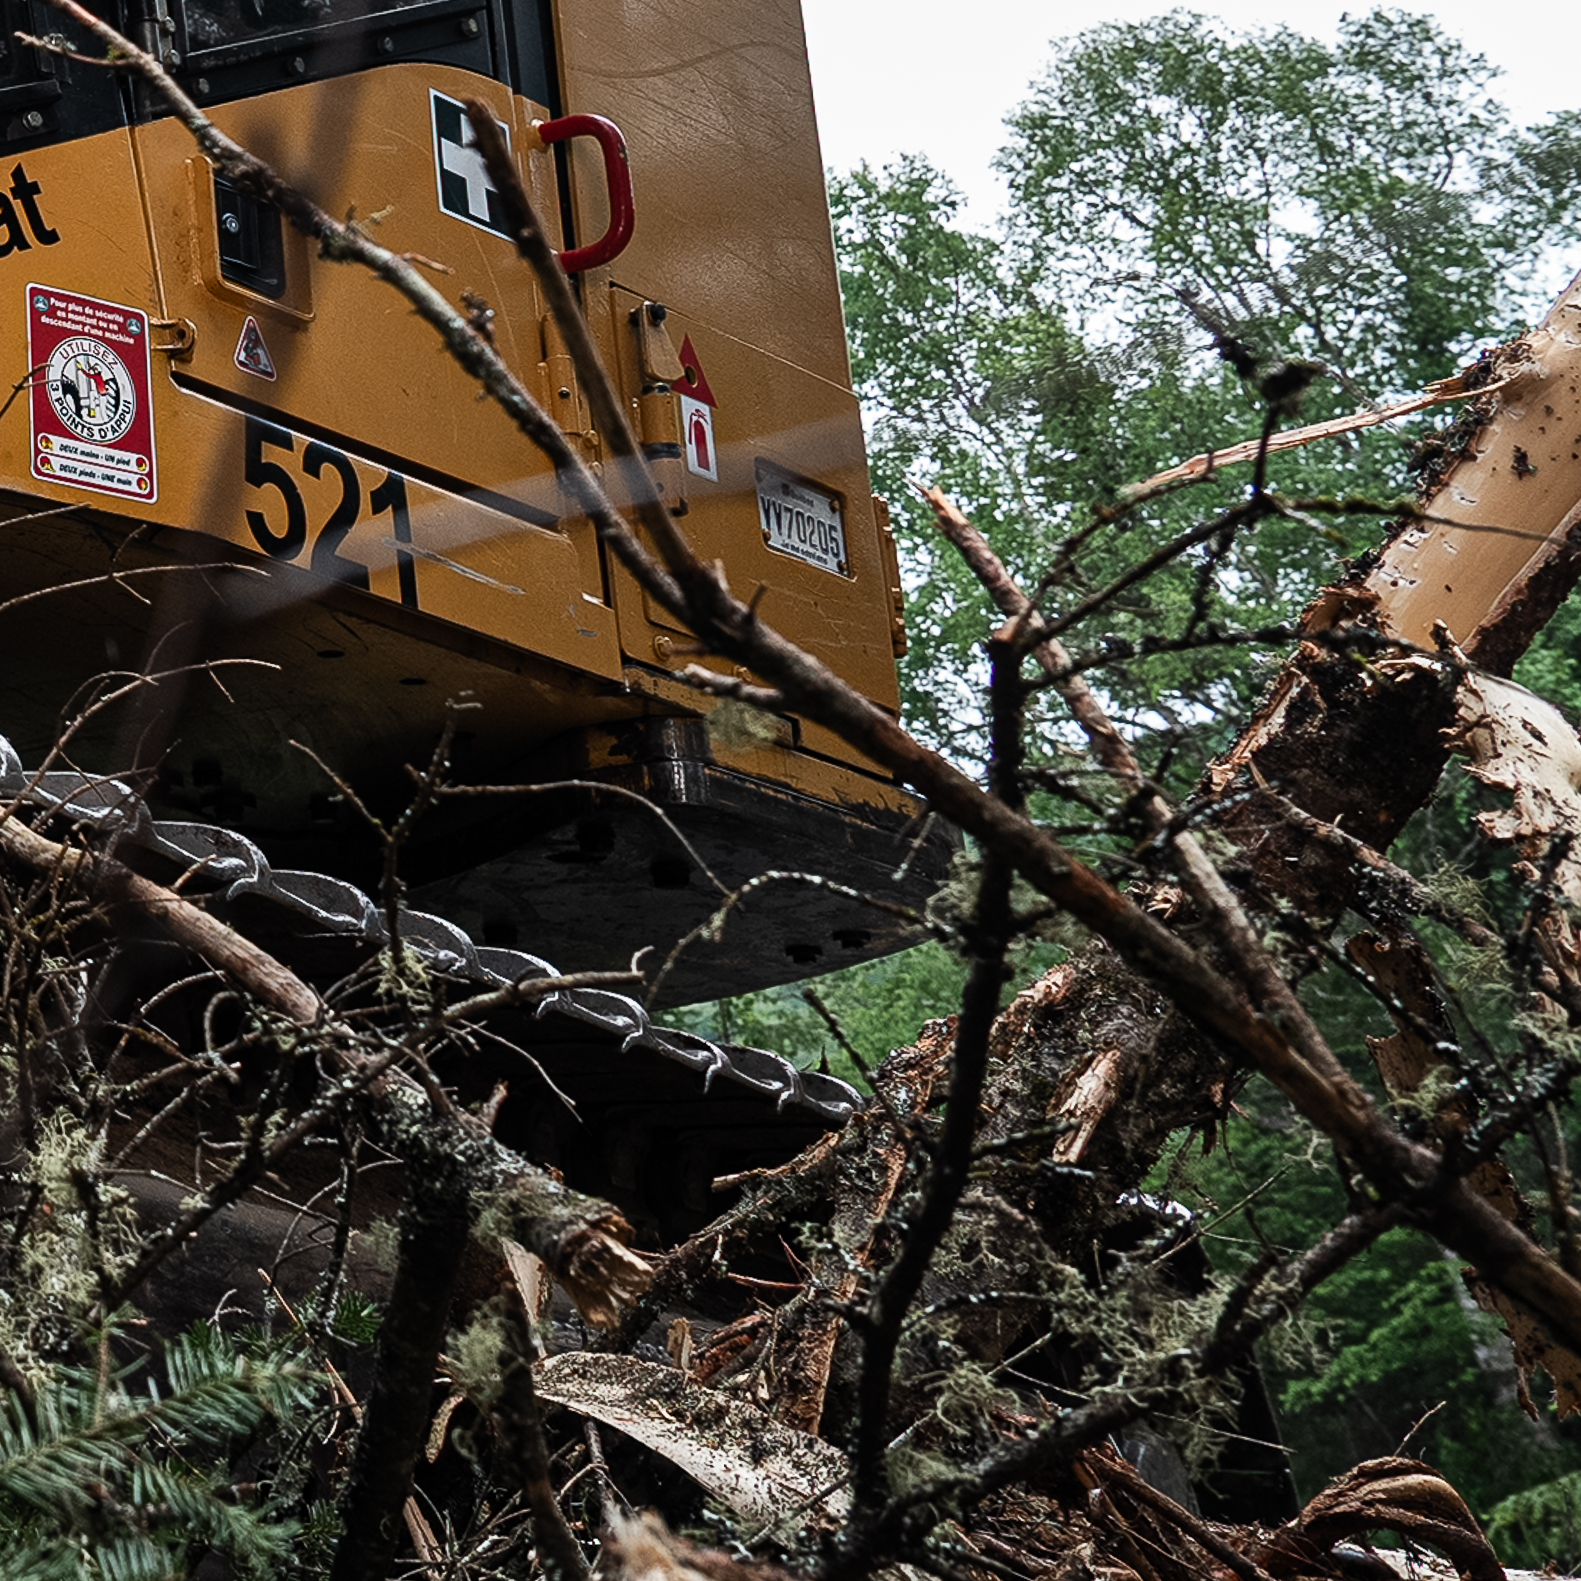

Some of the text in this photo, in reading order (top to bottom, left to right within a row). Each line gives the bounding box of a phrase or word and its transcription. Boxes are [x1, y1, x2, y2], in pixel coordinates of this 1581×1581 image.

[50, 297, 67, 308] Pour
[68, 302, 83, 313] plus
[84, 306, 93, 315] de
[41, 315, 83, 331] descendant
[104, 331, 135, 345] machine
[57, 310, 118, 331] en montant ou en
[59, 342, 118, 369] UTILISEZ
[50, 383, 132, 439] 3 POINTS D'APPUI
[59, 463, 78, 474] DEUX
[116, 457, 131, 466] pied
[245, 415, 418, 609] 521
